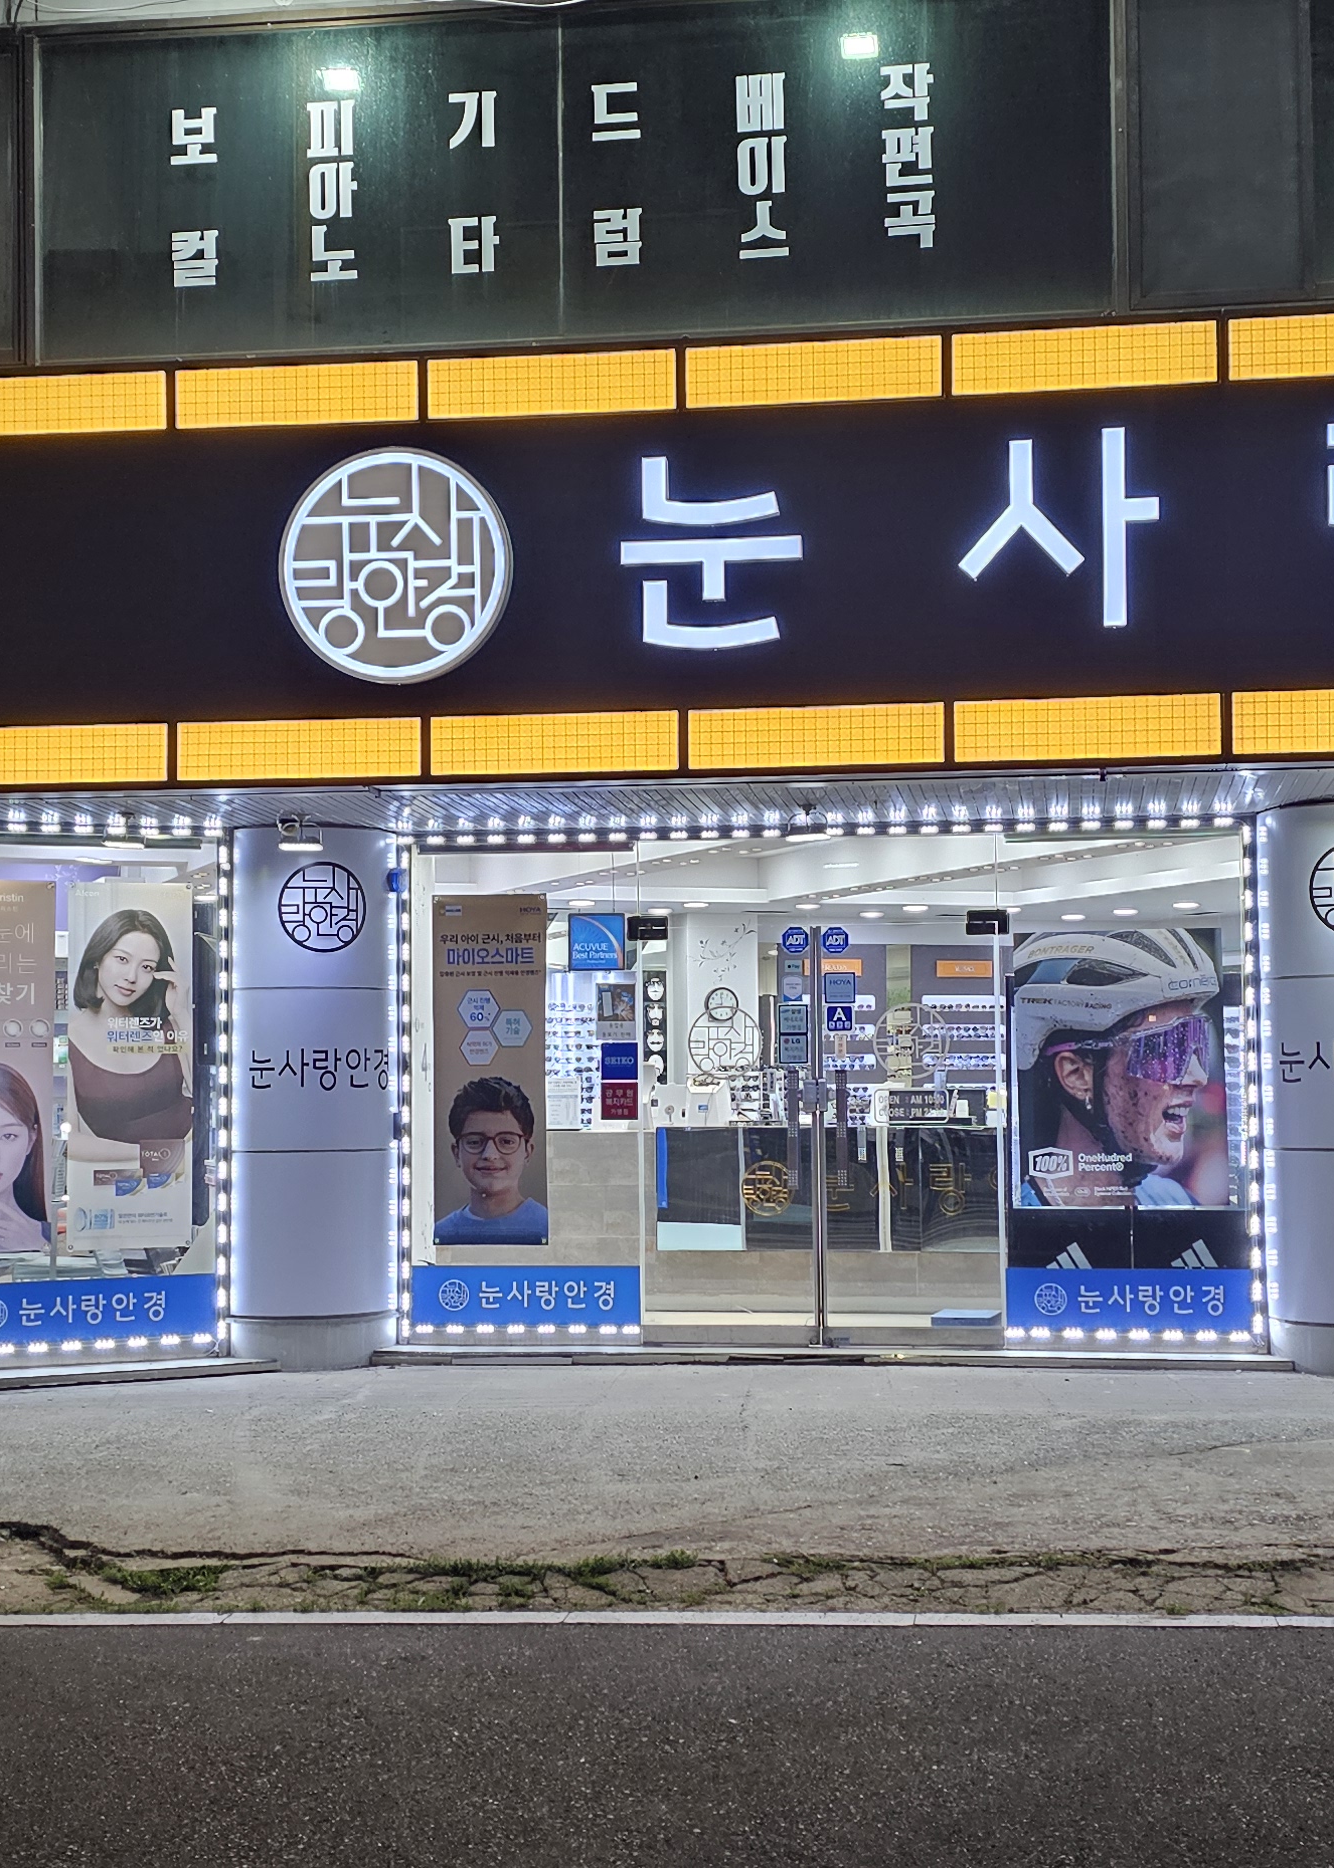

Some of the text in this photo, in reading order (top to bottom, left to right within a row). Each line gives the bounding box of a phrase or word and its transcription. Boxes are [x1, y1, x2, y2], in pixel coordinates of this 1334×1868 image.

[879, 62, 937, 249] 작편곡
[591, 81, 643, 267] 드럼
[736, 72, 790, 259] 베이스
[307, 99, 358, 282] 피아노
[447, 90, 500, 274] 기타
[170, 107, 217, 288] 보컬
[439, 933, 458, 945] 우리
[460, 933, 479, 945] 아이
[505, 932, 542, 944] 처음부터
[573, 943, 608, 951] ACUVUE
[787, 934, 805, 946] ADT
[826, 934, 845, 946] ADT
[447, 946, 535, 966] 마이오스마트
[572, 951, 589, 959] Best
[1027, 945, 1095, 959] BONTRAGER
[1020, 996, 1053, 1005] TREK
[107, 1017, 163, 1030] 워터렌즈가
[107, 1030, 189, 1043] 워터렌즈인 이유
[248, 1046, 390, 1092] 눈사랑안경
[604, 1056, 634, 1065] SEIKO
[1035, 1155, 1068, 1172] 100%
[479, 1280, 617, 1311] 눈사랑안경
[1077, 1284, 1225, 1316] 눈사랑안경
[19, 1290, 167, 1327] 눈사랑안경
